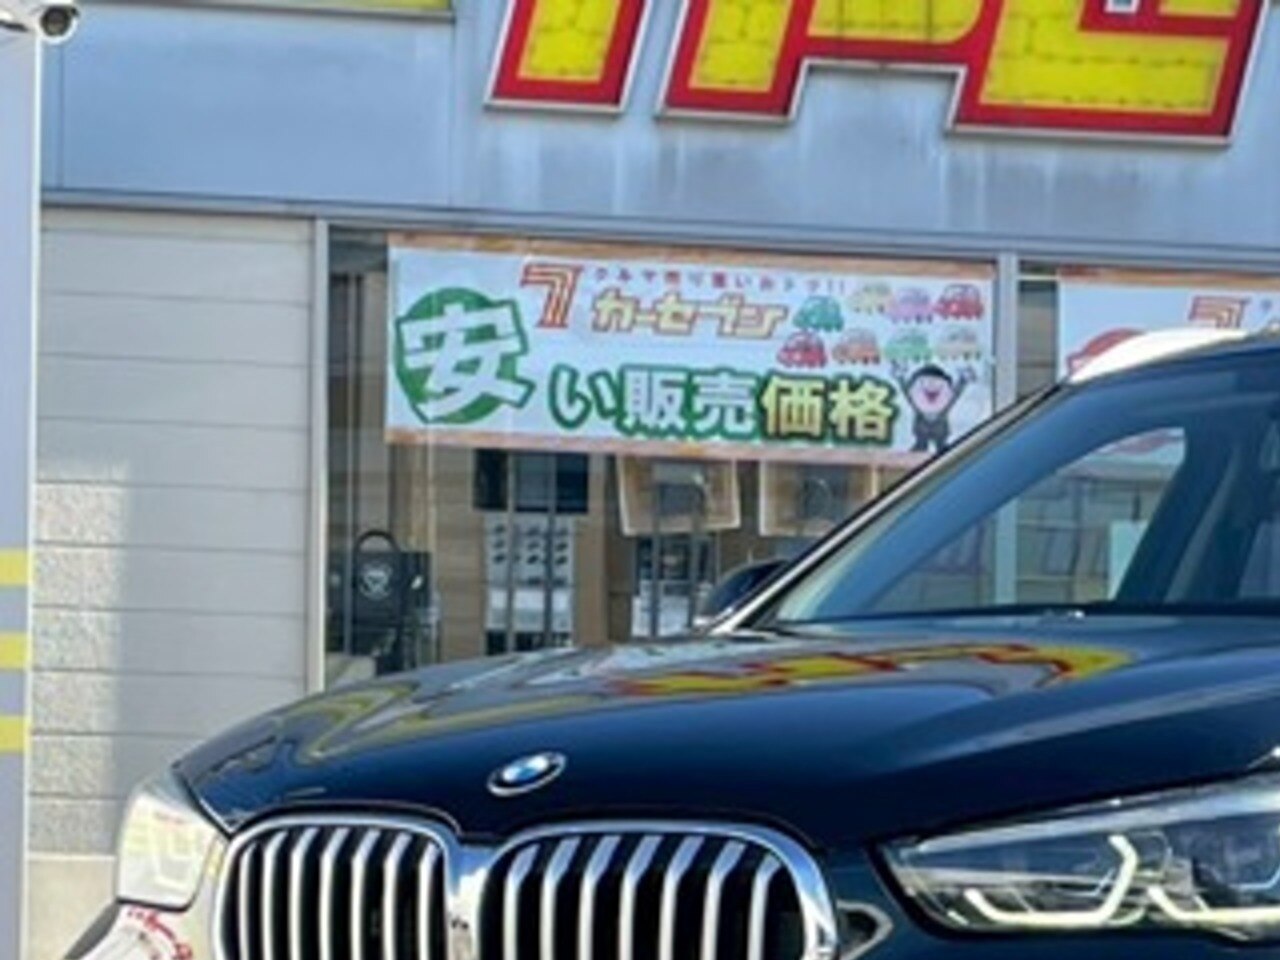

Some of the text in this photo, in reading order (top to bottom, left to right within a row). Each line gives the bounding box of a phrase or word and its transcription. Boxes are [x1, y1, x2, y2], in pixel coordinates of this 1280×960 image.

[591, 287, 788, 338] カーセブン
[394, 287, 899, 444] 安 い販売価格
